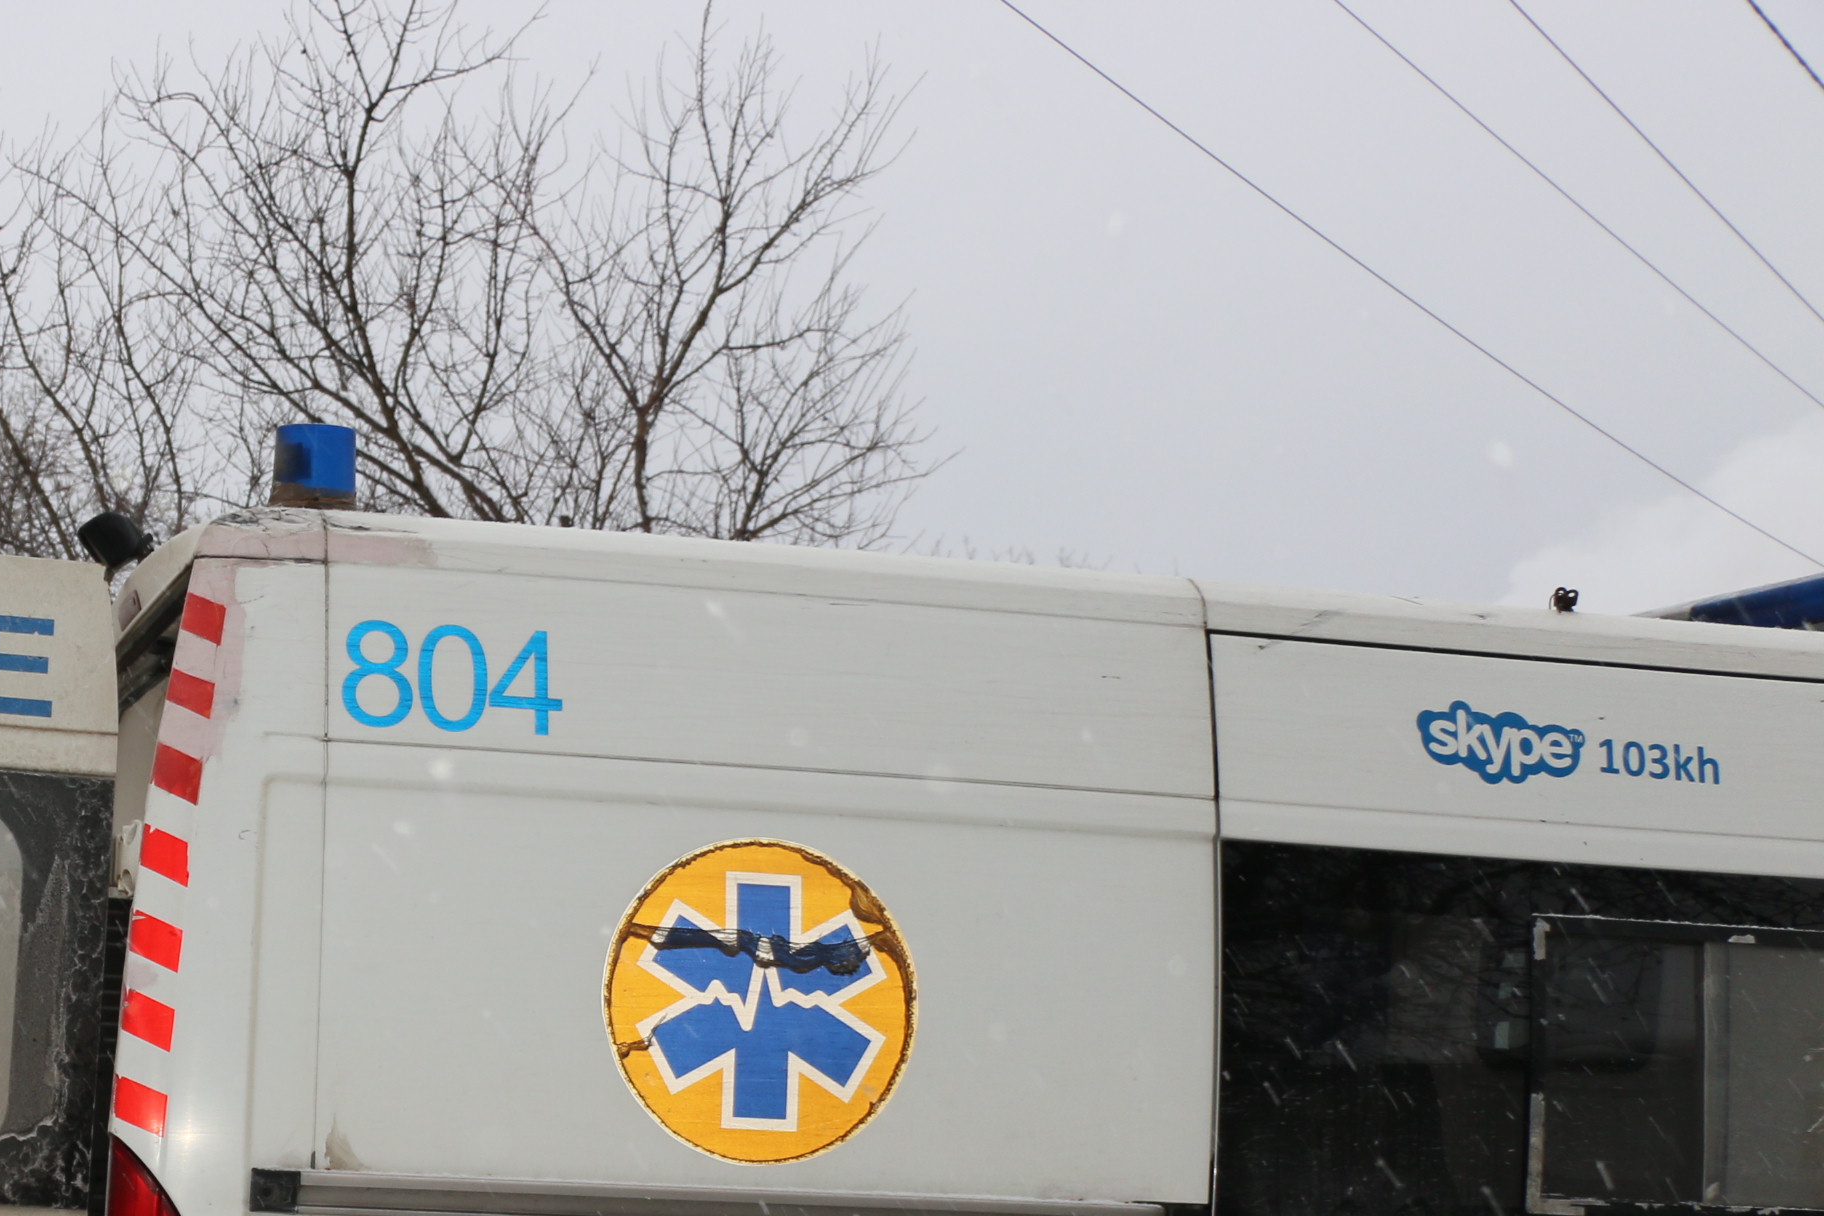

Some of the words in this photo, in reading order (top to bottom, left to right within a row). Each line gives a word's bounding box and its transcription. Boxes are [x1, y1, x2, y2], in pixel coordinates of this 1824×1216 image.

[341, 619, 564, 736] 804
[1428, 708, 1574, 778] skype
[1598, 738, 1721, 785] 103kh
